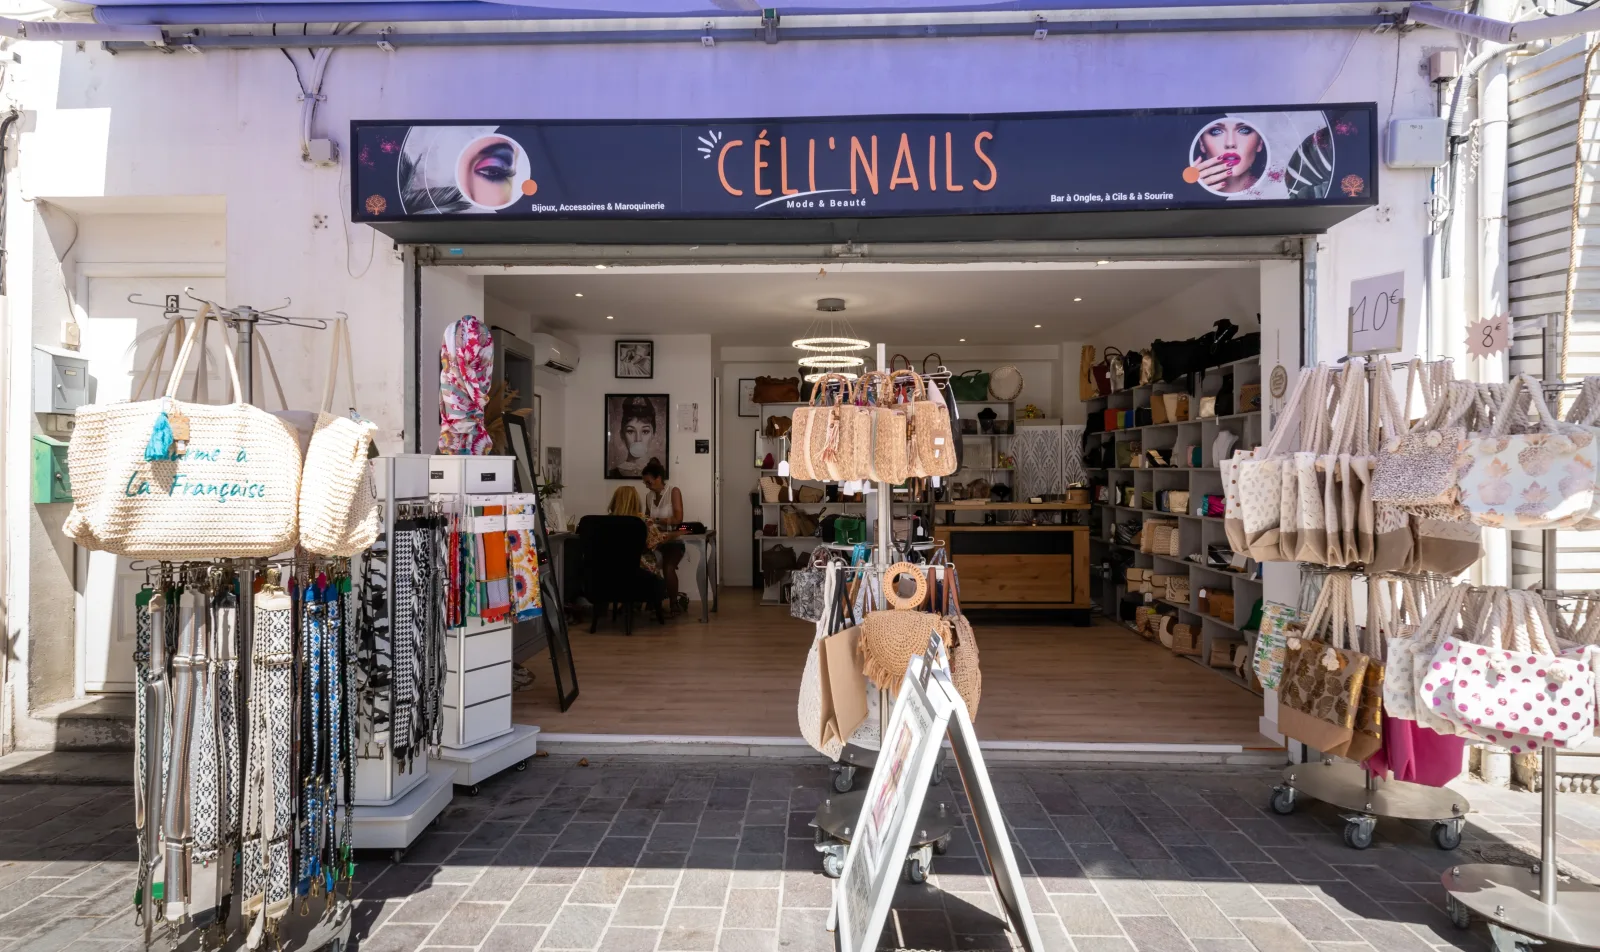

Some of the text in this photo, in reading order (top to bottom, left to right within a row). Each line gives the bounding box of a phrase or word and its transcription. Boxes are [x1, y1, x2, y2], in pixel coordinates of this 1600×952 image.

[786, 198, 867, 208] Mode & Beauté
[1050, 191, 1174, 203] Bar à Ongles, à Cils & à Sourire
[531, 201, 665, 213] Bijoux, Accessoires & Maroquinerie
[167, 295, 177, 313] 6
[1352, 288, 1400, 333] 10€
[1482, 321, 1502, 348] 8€
[236, 446, 248, 463] à
[125, 471, 266, 504] La Française
